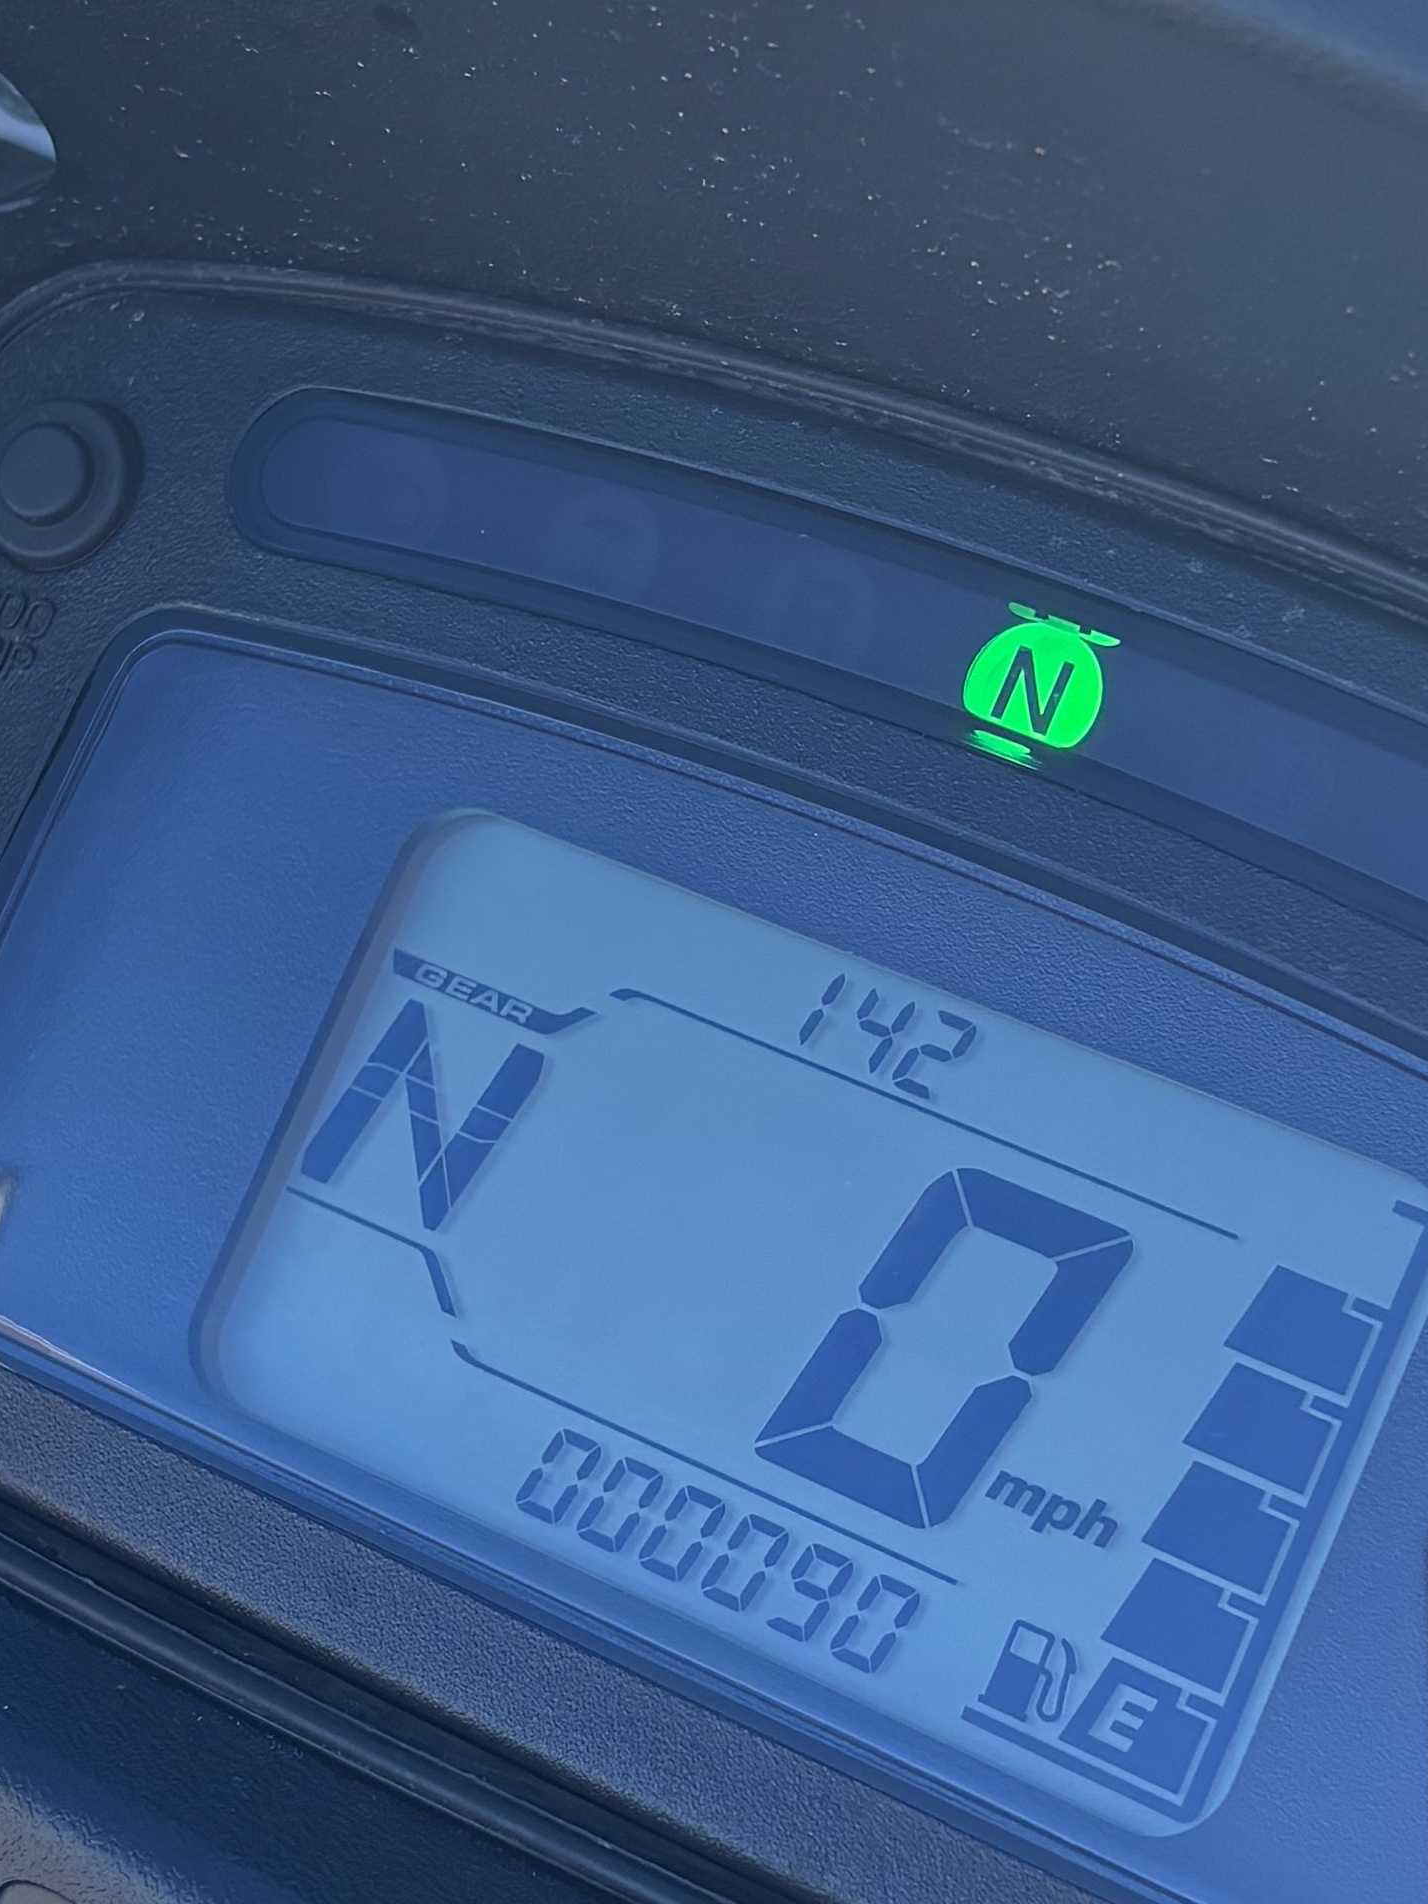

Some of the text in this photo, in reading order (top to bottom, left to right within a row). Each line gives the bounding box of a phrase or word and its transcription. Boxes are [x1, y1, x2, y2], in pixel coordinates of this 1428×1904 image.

[991, 645, 1075, 737] N
[414, 962, 534, 1025] GEAR
[799, 972, 978, 1100] 142
[299, 999, 546, 1232] N
[753, 1166, 1135, 1550] 0 mph
[515, 1427, 921, 1675] 000090
[1087, 1683, 1160, 1753] E
